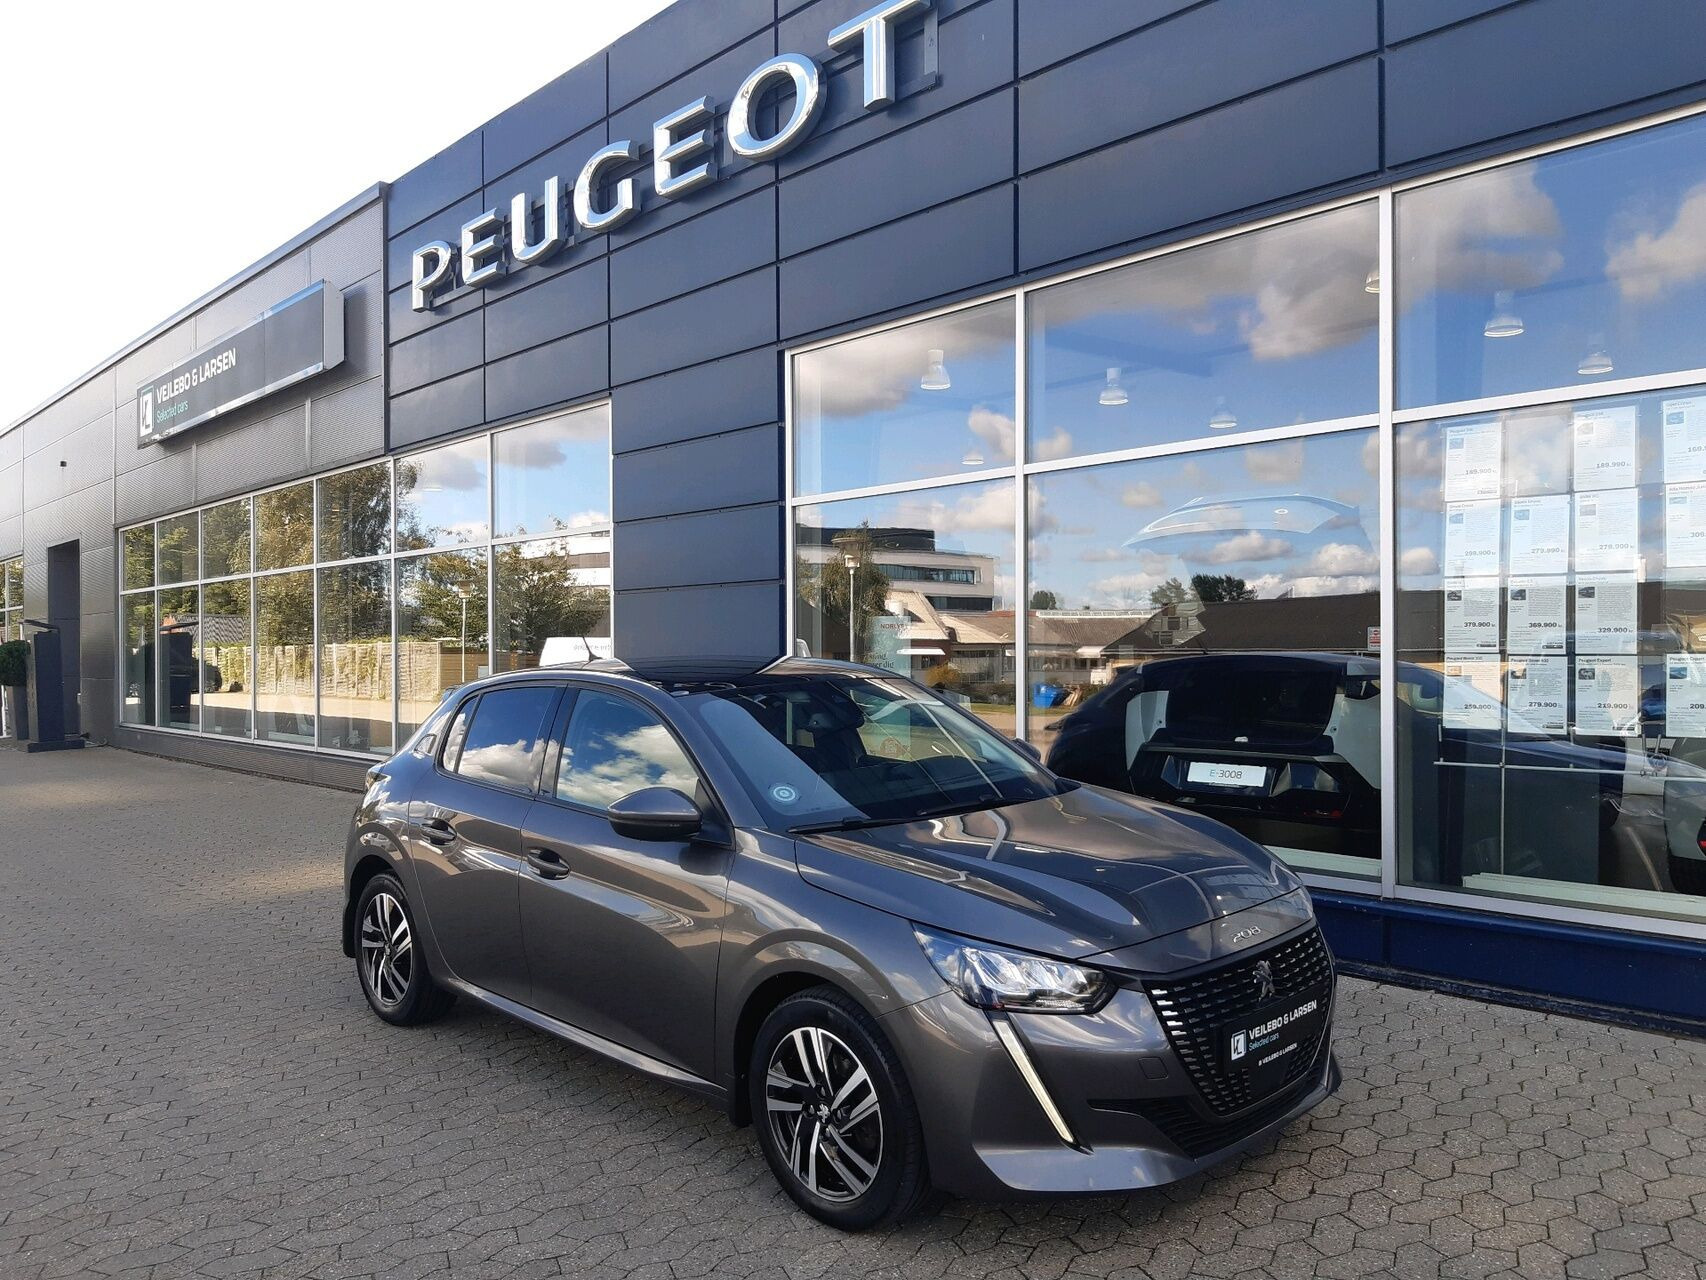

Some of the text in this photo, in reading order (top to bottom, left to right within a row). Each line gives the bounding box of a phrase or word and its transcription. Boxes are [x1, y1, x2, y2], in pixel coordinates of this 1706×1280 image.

[411, 0, 931, 312] PEUGEOT
[156, 347, 236, 404] VEJLEBO & LARSEN
[156, 400, 189, 424] Selected cars
[1209, 769, 1243, 780] E-3008
[1232, 926, 1261, 943] 208
[1248, 999, 1317, 1040] VEJLEBO & LARSEN
